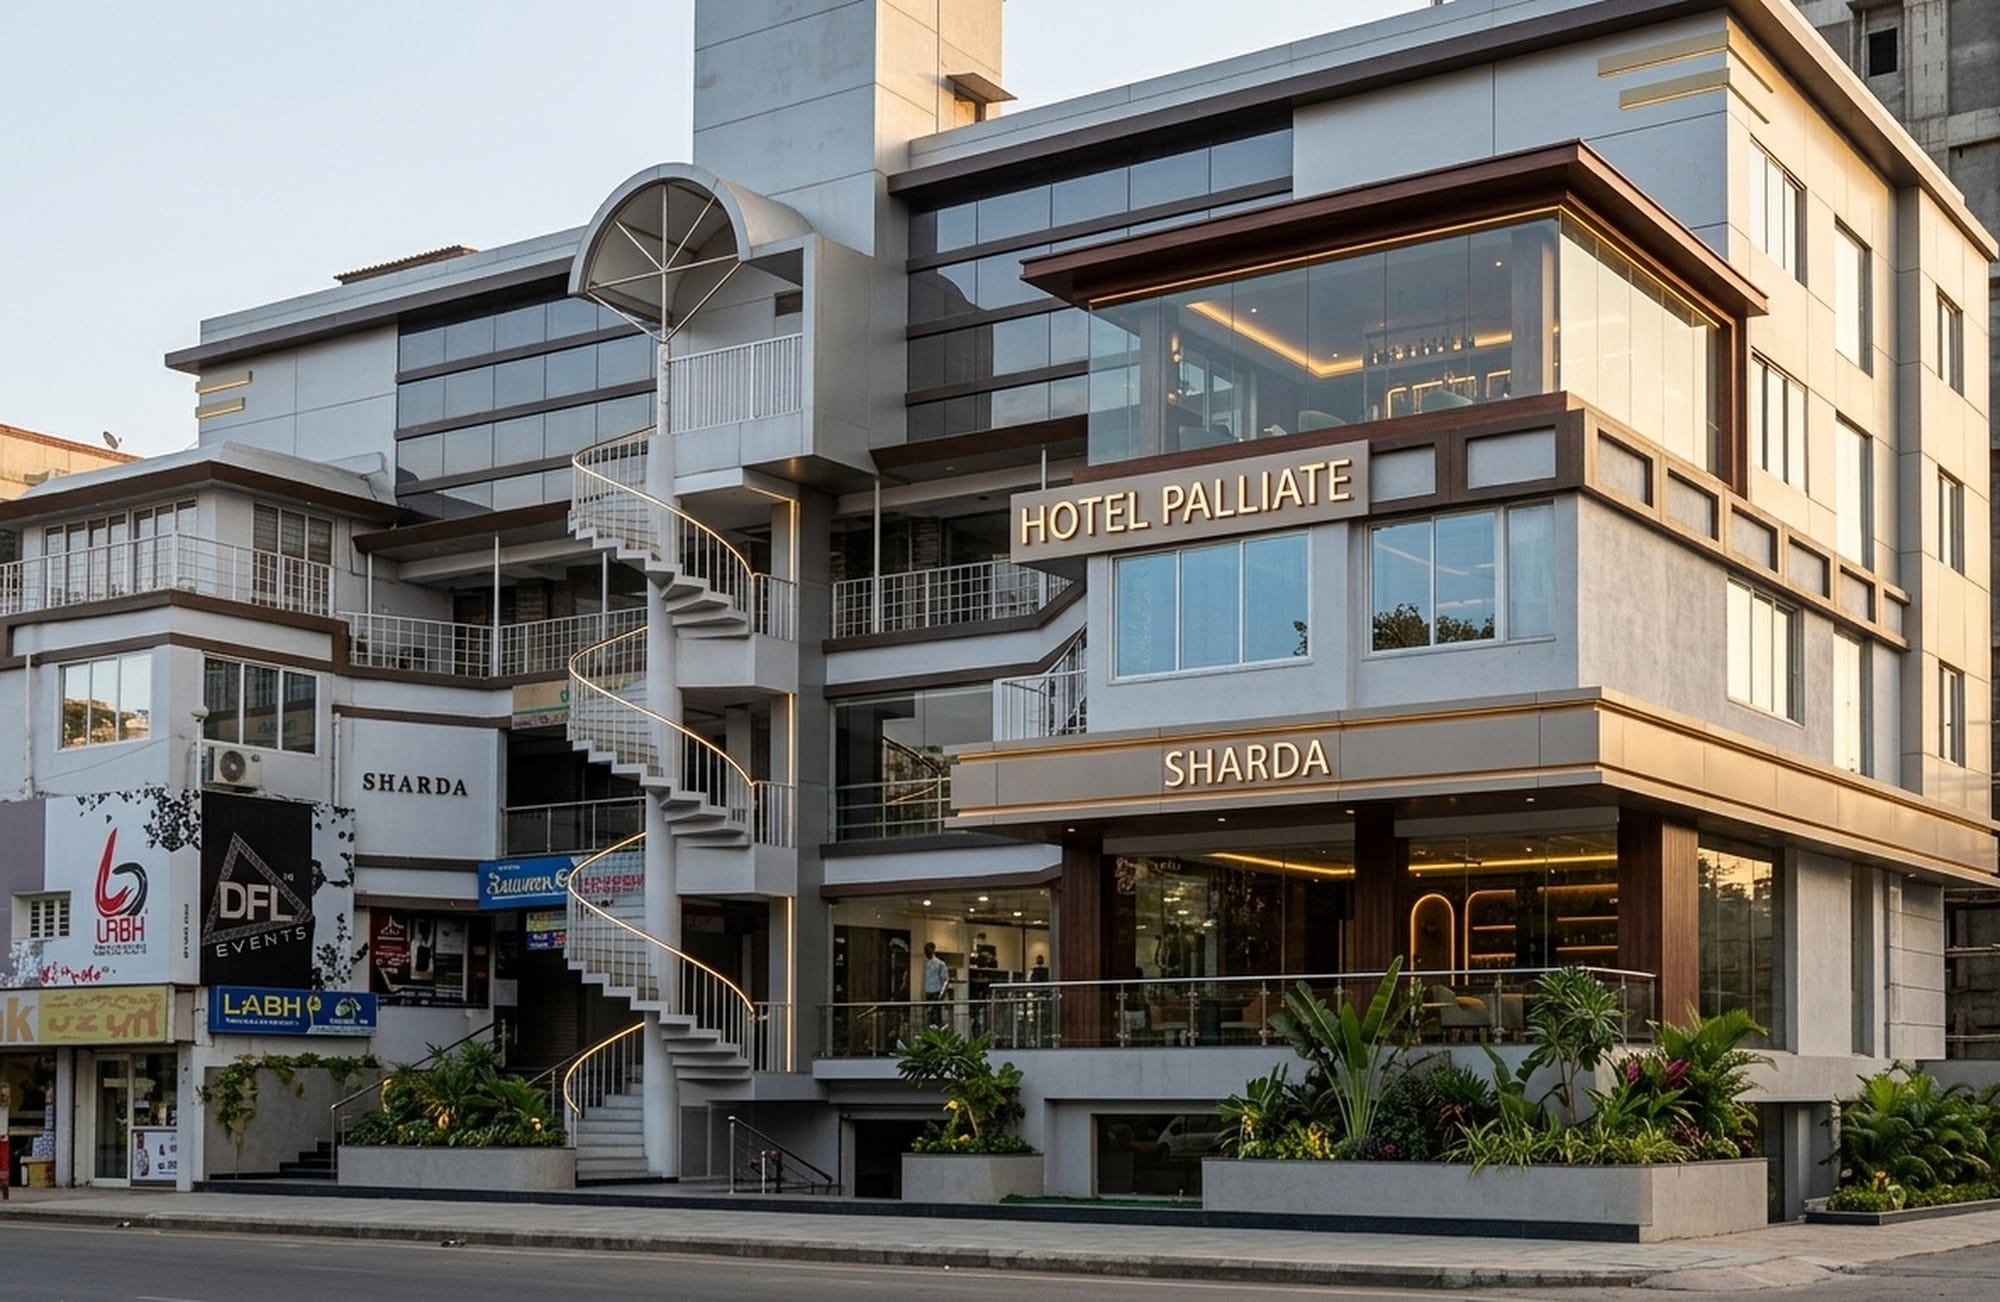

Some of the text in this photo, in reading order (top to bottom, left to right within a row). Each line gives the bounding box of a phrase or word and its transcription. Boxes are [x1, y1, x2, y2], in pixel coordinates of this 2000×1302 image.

[1021, 458, 1352, 546] HOTEL PALLIATE
[1164, 738, 1330, 787] SHARDA
[363, 772, 468, 796] SHARDA
[219, 880, 293, 922] DFL
[216, 926, 307, 957] EVENTS
[223, 993, 301, 1018] LABH
